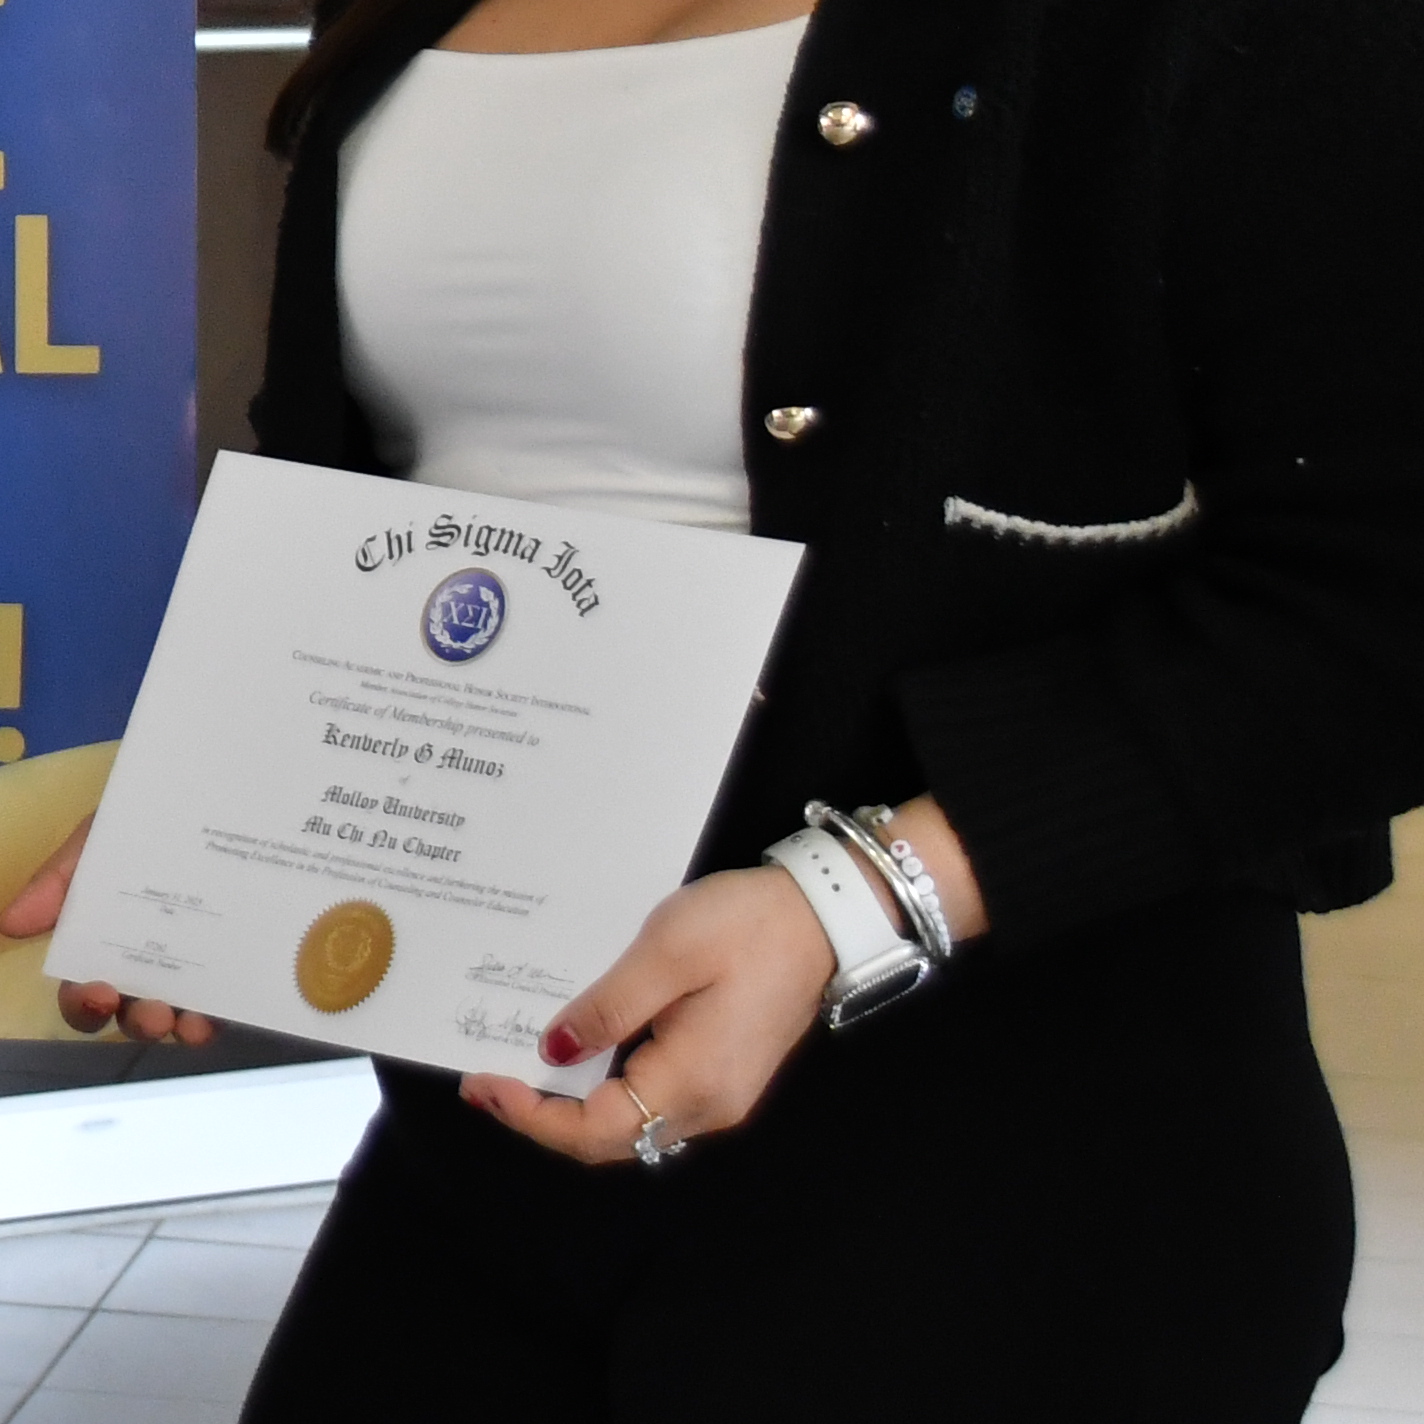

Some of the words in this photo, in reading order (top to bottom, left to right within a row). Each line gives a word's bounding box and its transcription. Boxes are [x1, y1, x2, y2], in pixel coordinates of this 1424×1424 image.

[355, 520, 415, 573] Chi
[425, 513, 543, 564] Sigma
[541, 540, 600, 618] Iota
[308, 690, 373, 715] Certificate
[373, 704, 392, 720] of
[391, 706, 465, 736] Membership
[463, 724, 528, 745] presented
[526, 735, 541, 747] to
[413, 742, 434, 764] G
[435, 747, 505, 779] Munoz
[320, 784, 379, 810] Molloy
[382, 795, 467, 831] University
[300, 815, 333, 837] Mu
[336, 822, 365, 844] Chi
[366, 829, 398, 851] Nu
[402, 836, 463, 863] Chapter
